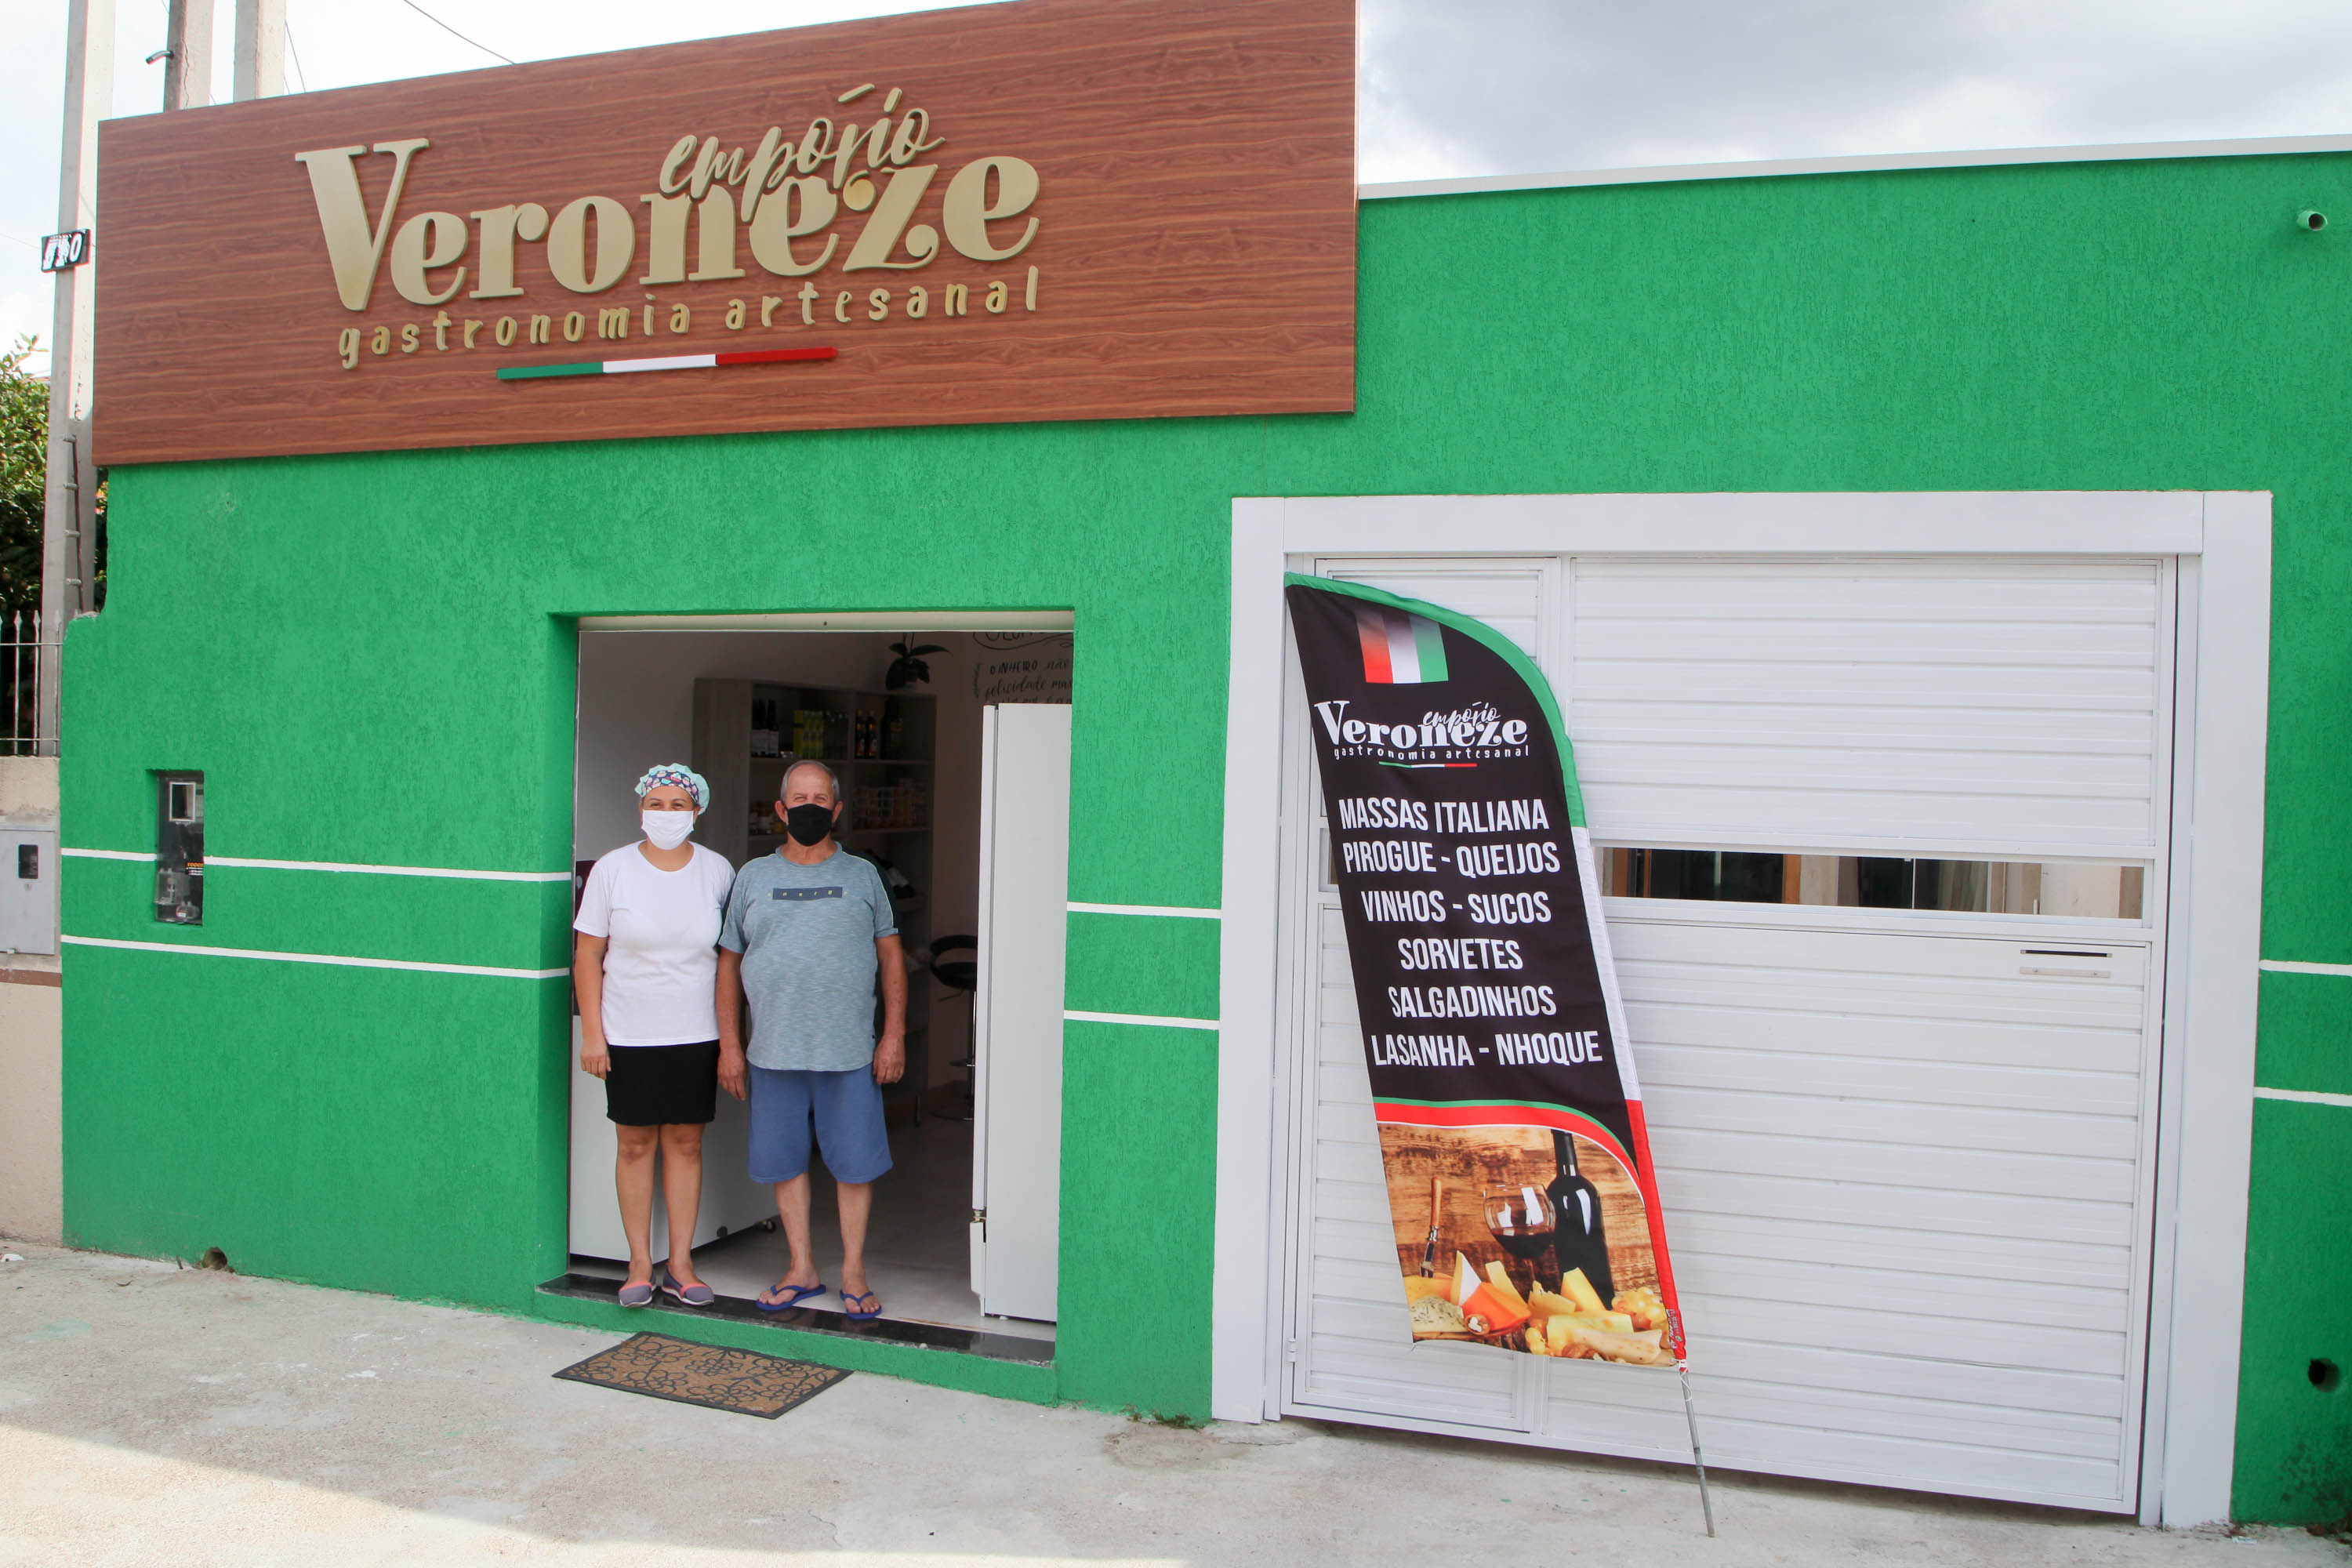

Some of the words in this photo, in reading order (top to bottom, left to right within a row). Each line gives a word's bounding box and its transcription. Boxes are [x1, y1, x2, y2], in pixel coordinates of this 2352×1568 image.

[295, 137, 1040, 311] Veroneze
[338, 292, 691, 370] gastronomia
[725, 264, 1039, 332] artesanal
[1313, 699, 1529, 750] Veroneze
[1334, 743, 1436, 760] gastronomia
[1446, 744, 1530, 760] artesanal
[1338, 797, 1429, 831] MASSAS
[1434, 798, 1551, 833] ITALIANA
[1342, 840, 1438, 873] PIROGUE
[1456, 841, 1562, 879] QUEIJOS
[1360, 890, 1447, 923] VINHOS
[1467, 891, 1552, 925] SUCOS
[1397, 938, 1524, 971] SORVETES
[1387, 985, 1558, 1018] SALGADINHOS
[1370, 1034, 1475, 1067] LASANHA
[1494, 1030, 1604, 1067] NHOQUE
